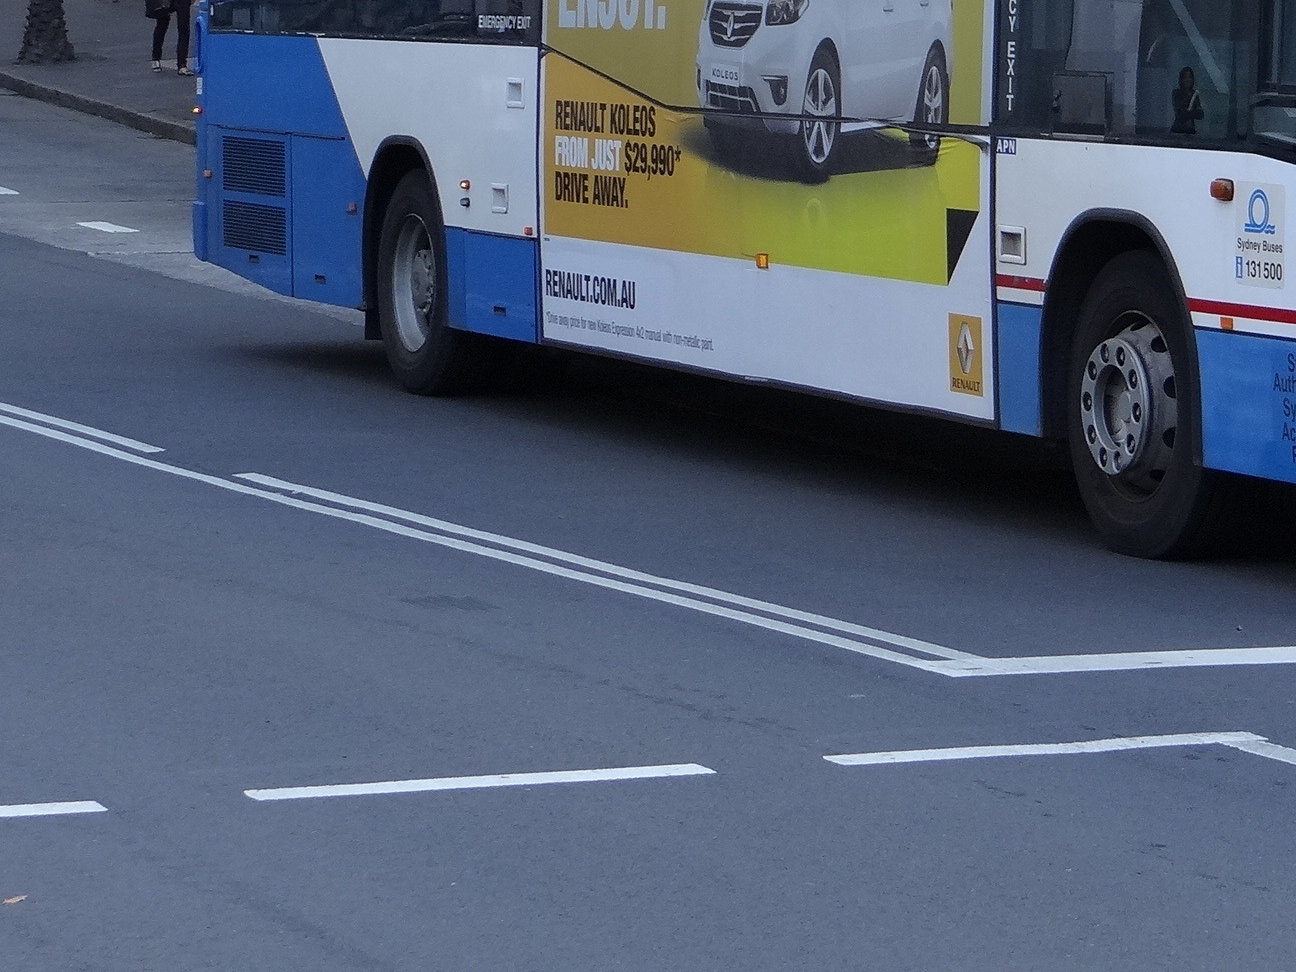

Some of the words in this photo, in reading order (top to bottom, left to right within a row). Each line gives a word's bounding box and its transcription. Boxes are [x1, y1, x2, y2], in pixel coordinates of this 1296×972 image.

[478, 15, 516, 29] EMERGENCY
[517, 16, 531, 29] EXIT
[712, 68, 738, 81] KOLEOS
[1006, 41, 1016, 111] EXIT
[555, 100, 606, 133] RENAULT
[610, 103, 656, 137] KOLEOS
[555, 135, 588, 168] FROM
[591, 138, 622, 171] JUST
[996, 139, 1015, 153] APN
[555, 171, 589, 204] DRIVE
[592, 175, 629, 208] AWAY.
[1237, 237, 1261, 253] Sydney
[1262, 240, 1283, 253] Buses
[545, 269, 636, 309] RENAULT.COM.AU
[952, 377, 980, 392] RENAULT
